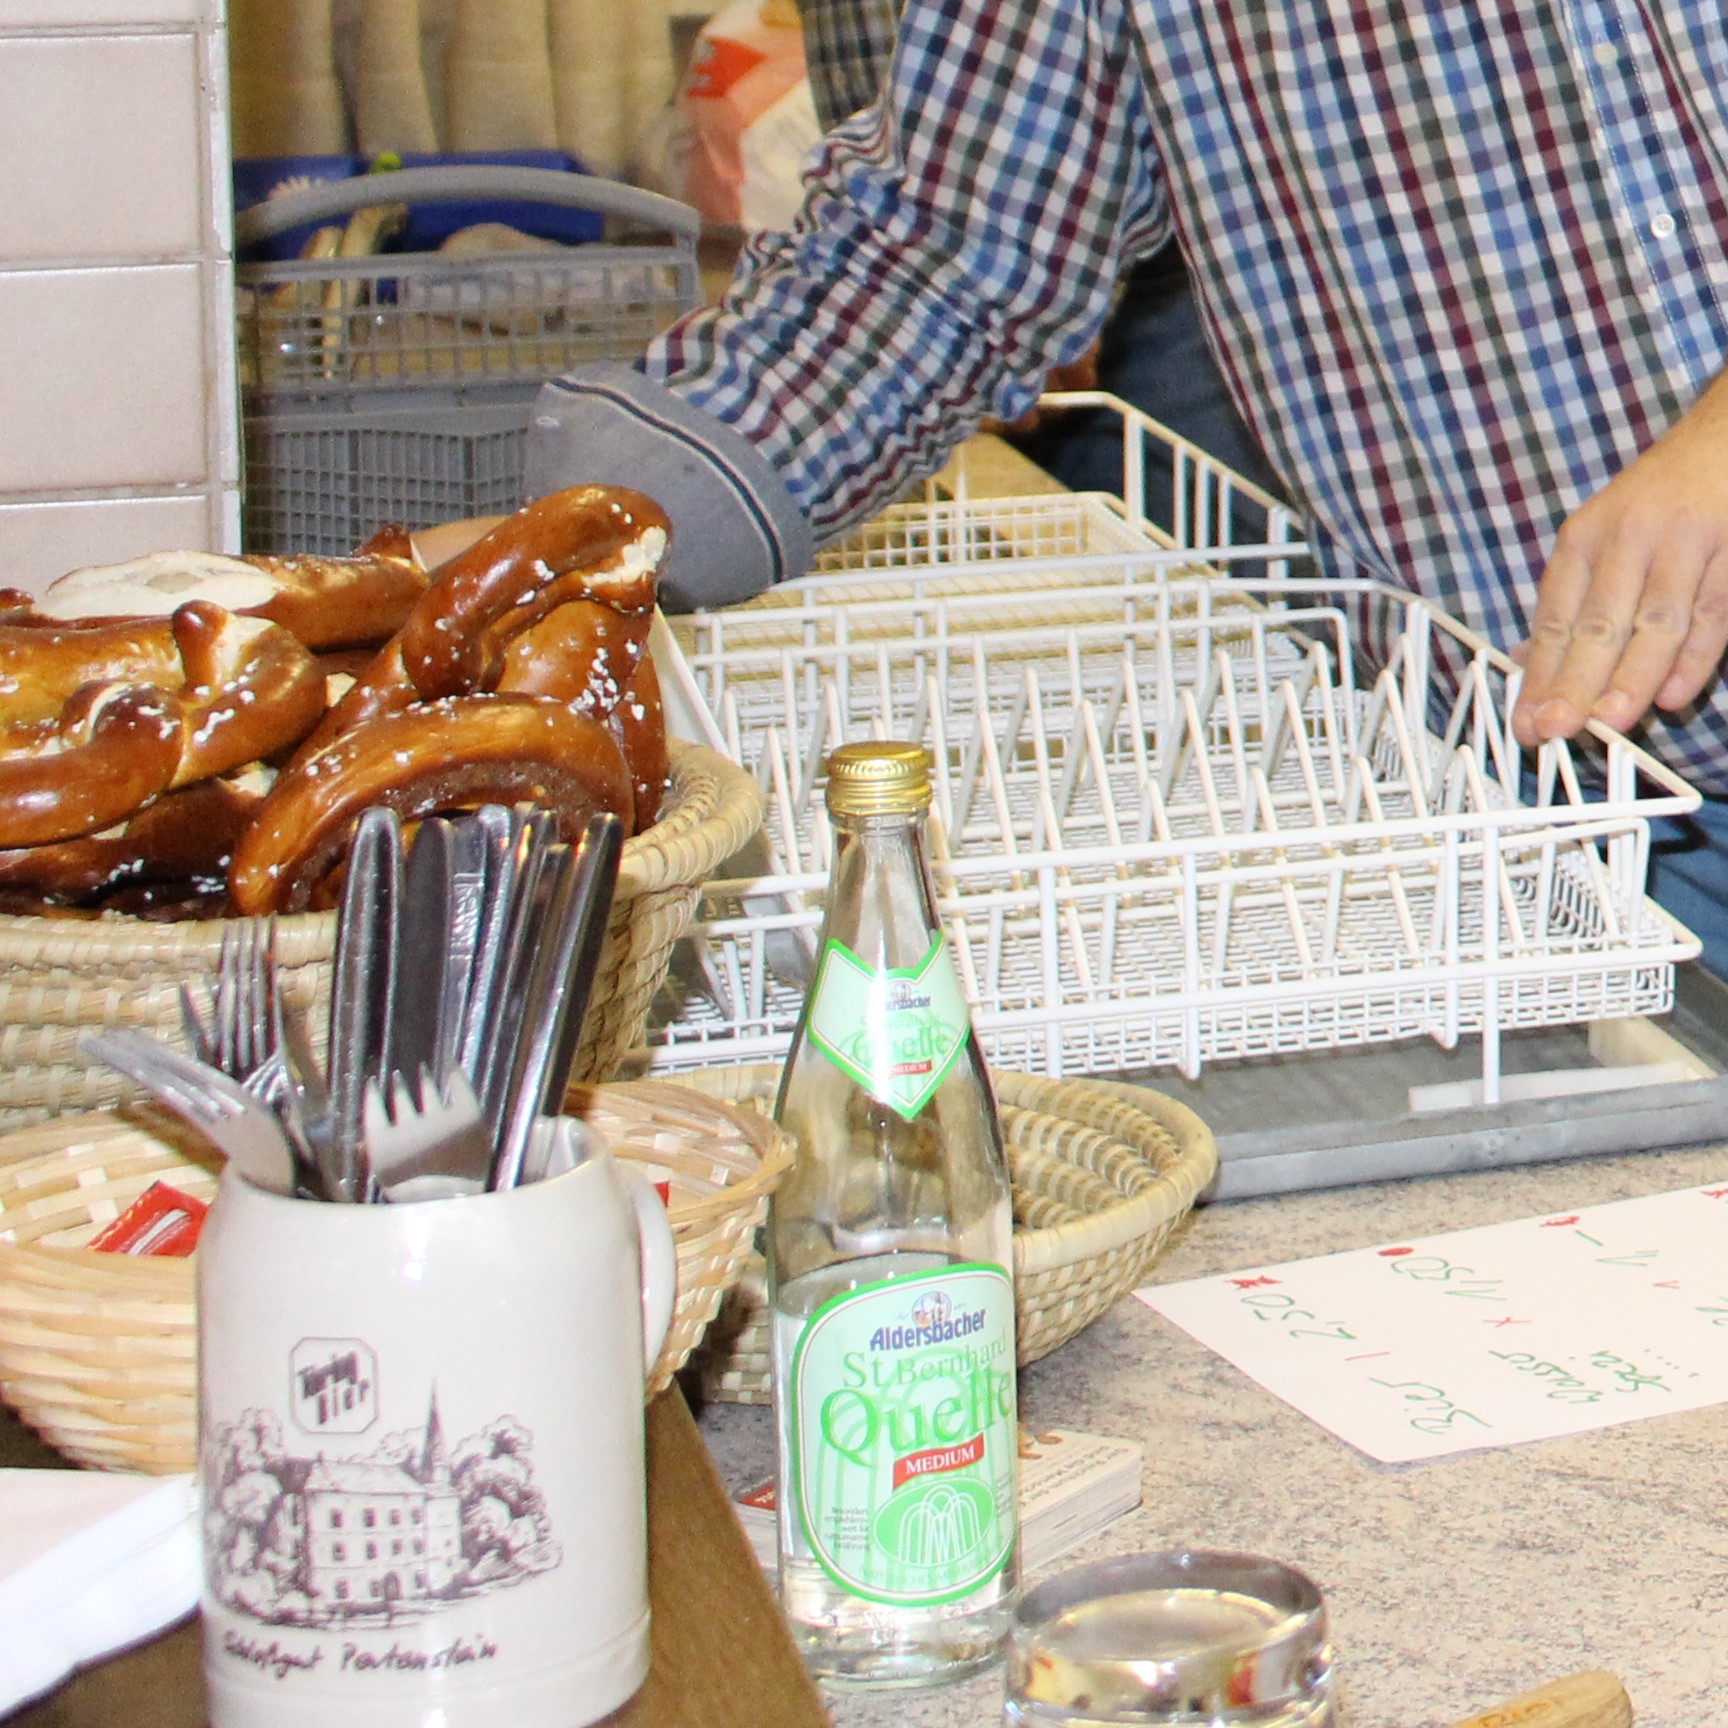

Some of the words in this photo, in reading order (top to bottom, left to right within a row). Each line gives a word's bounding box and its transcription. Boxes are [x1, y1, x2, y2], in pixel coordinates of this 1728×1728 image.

[870, 1309, 985, 1351] Aldersbacher
[1240, 1293, 1357, 1339] 2,50
[843, 1351, 882, 1388] St
[896, 1327, 1006, 1386] Bernhard
[820, 1366, 1010, 1467] Quelle
[1367, 1377, 1491, 1434] Bier
[905, 1445, 975, 1475] MEDIUM
